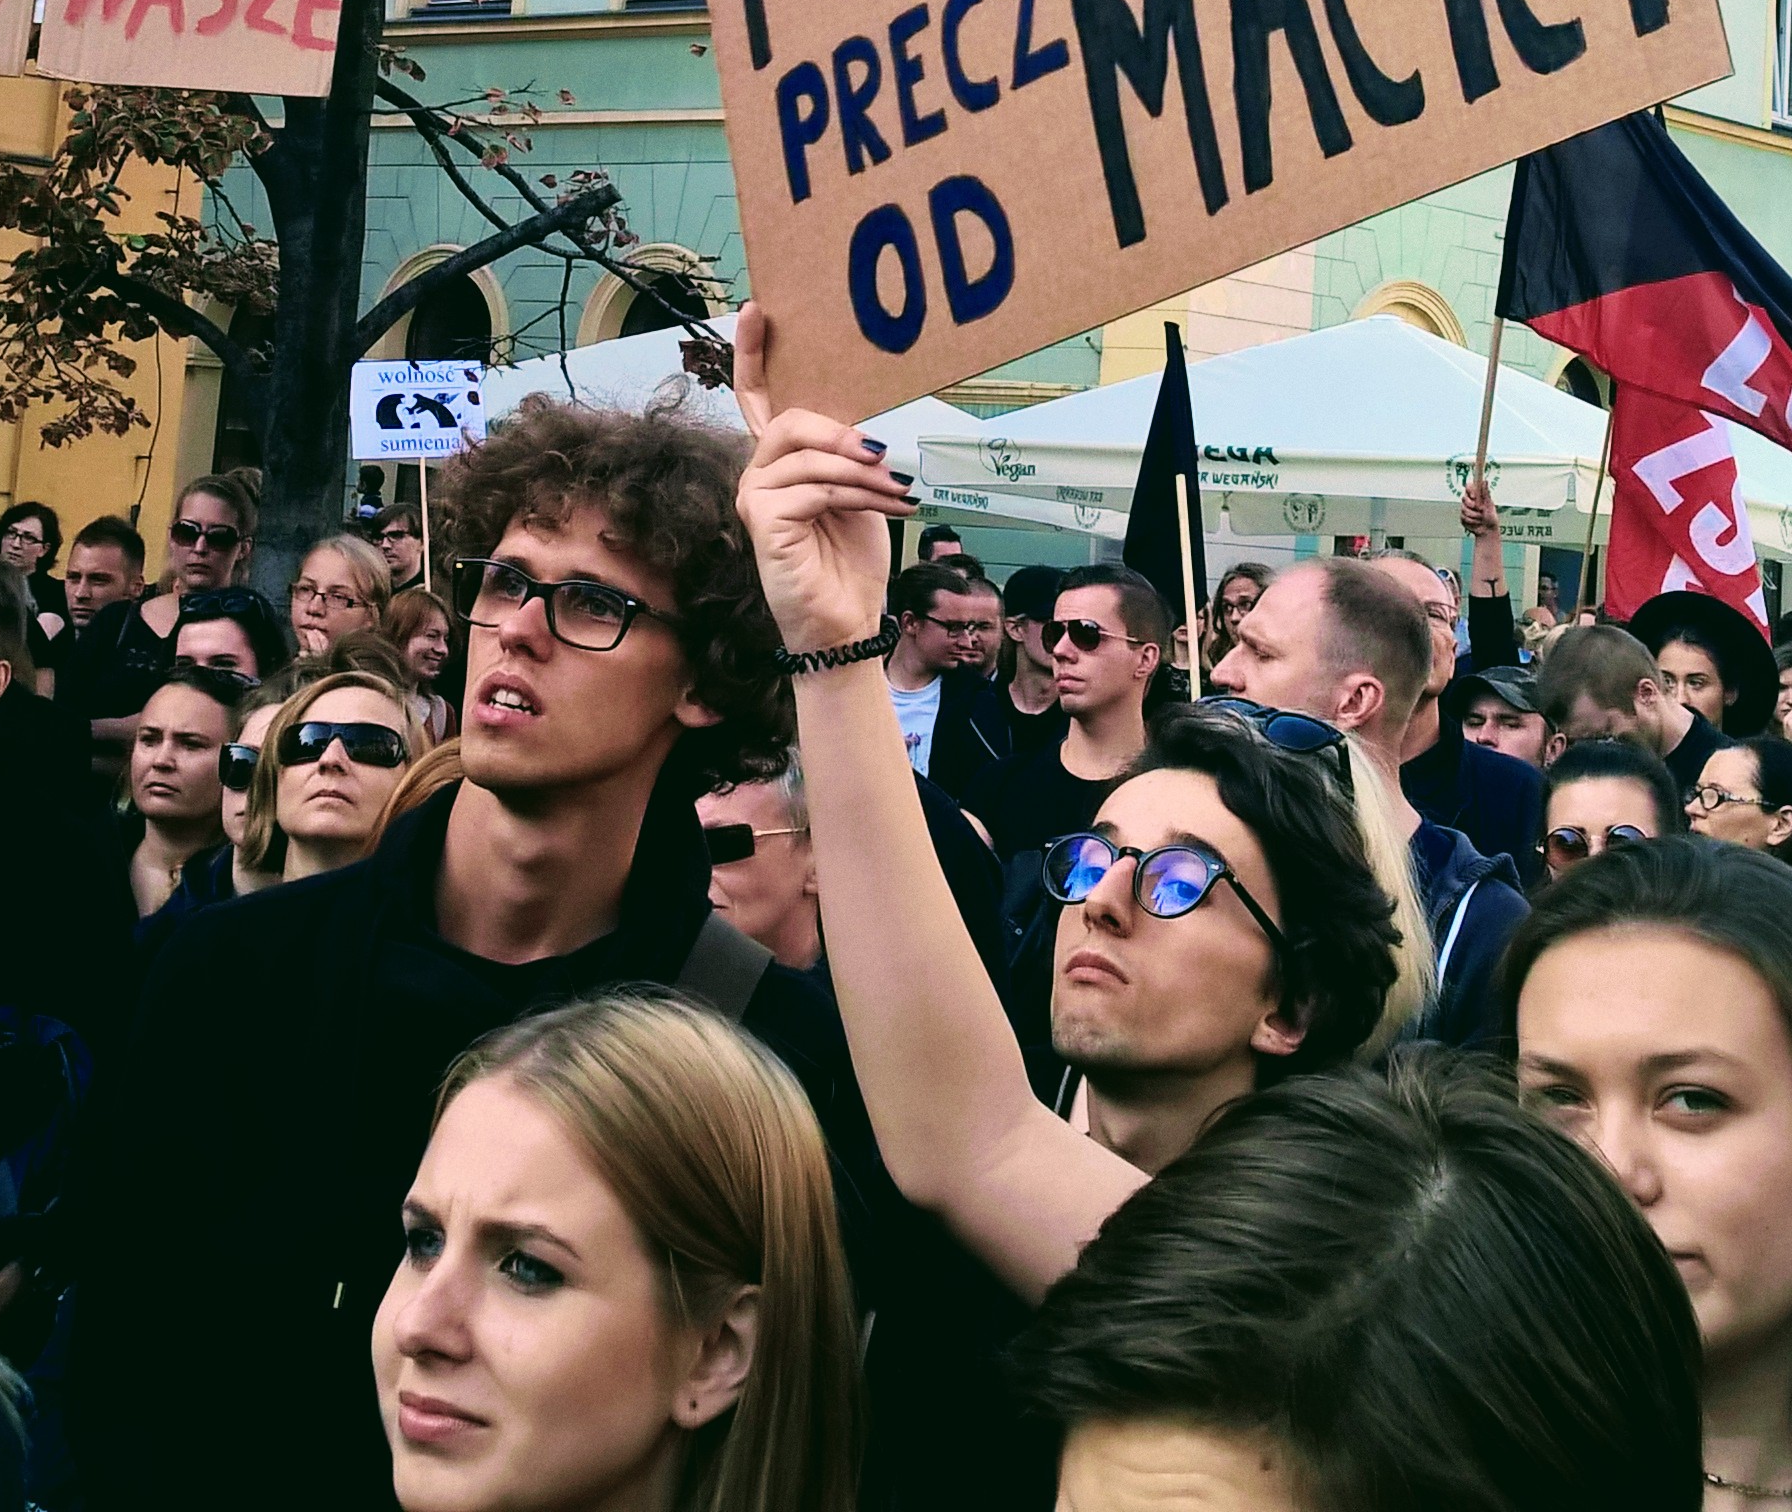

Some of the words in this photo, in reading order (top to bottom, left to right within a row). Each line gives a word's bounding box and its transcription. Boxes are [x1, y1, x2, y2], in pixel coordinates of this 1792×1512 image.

[848, 174, 1016, 355] OD
[377, 365, 456, 384] wolność
[380, 434, 461, 452] sumienia
[990, 454, 1036, 482] Vegan
[1212, 470, 1279, 489] WEGAŃSKI
